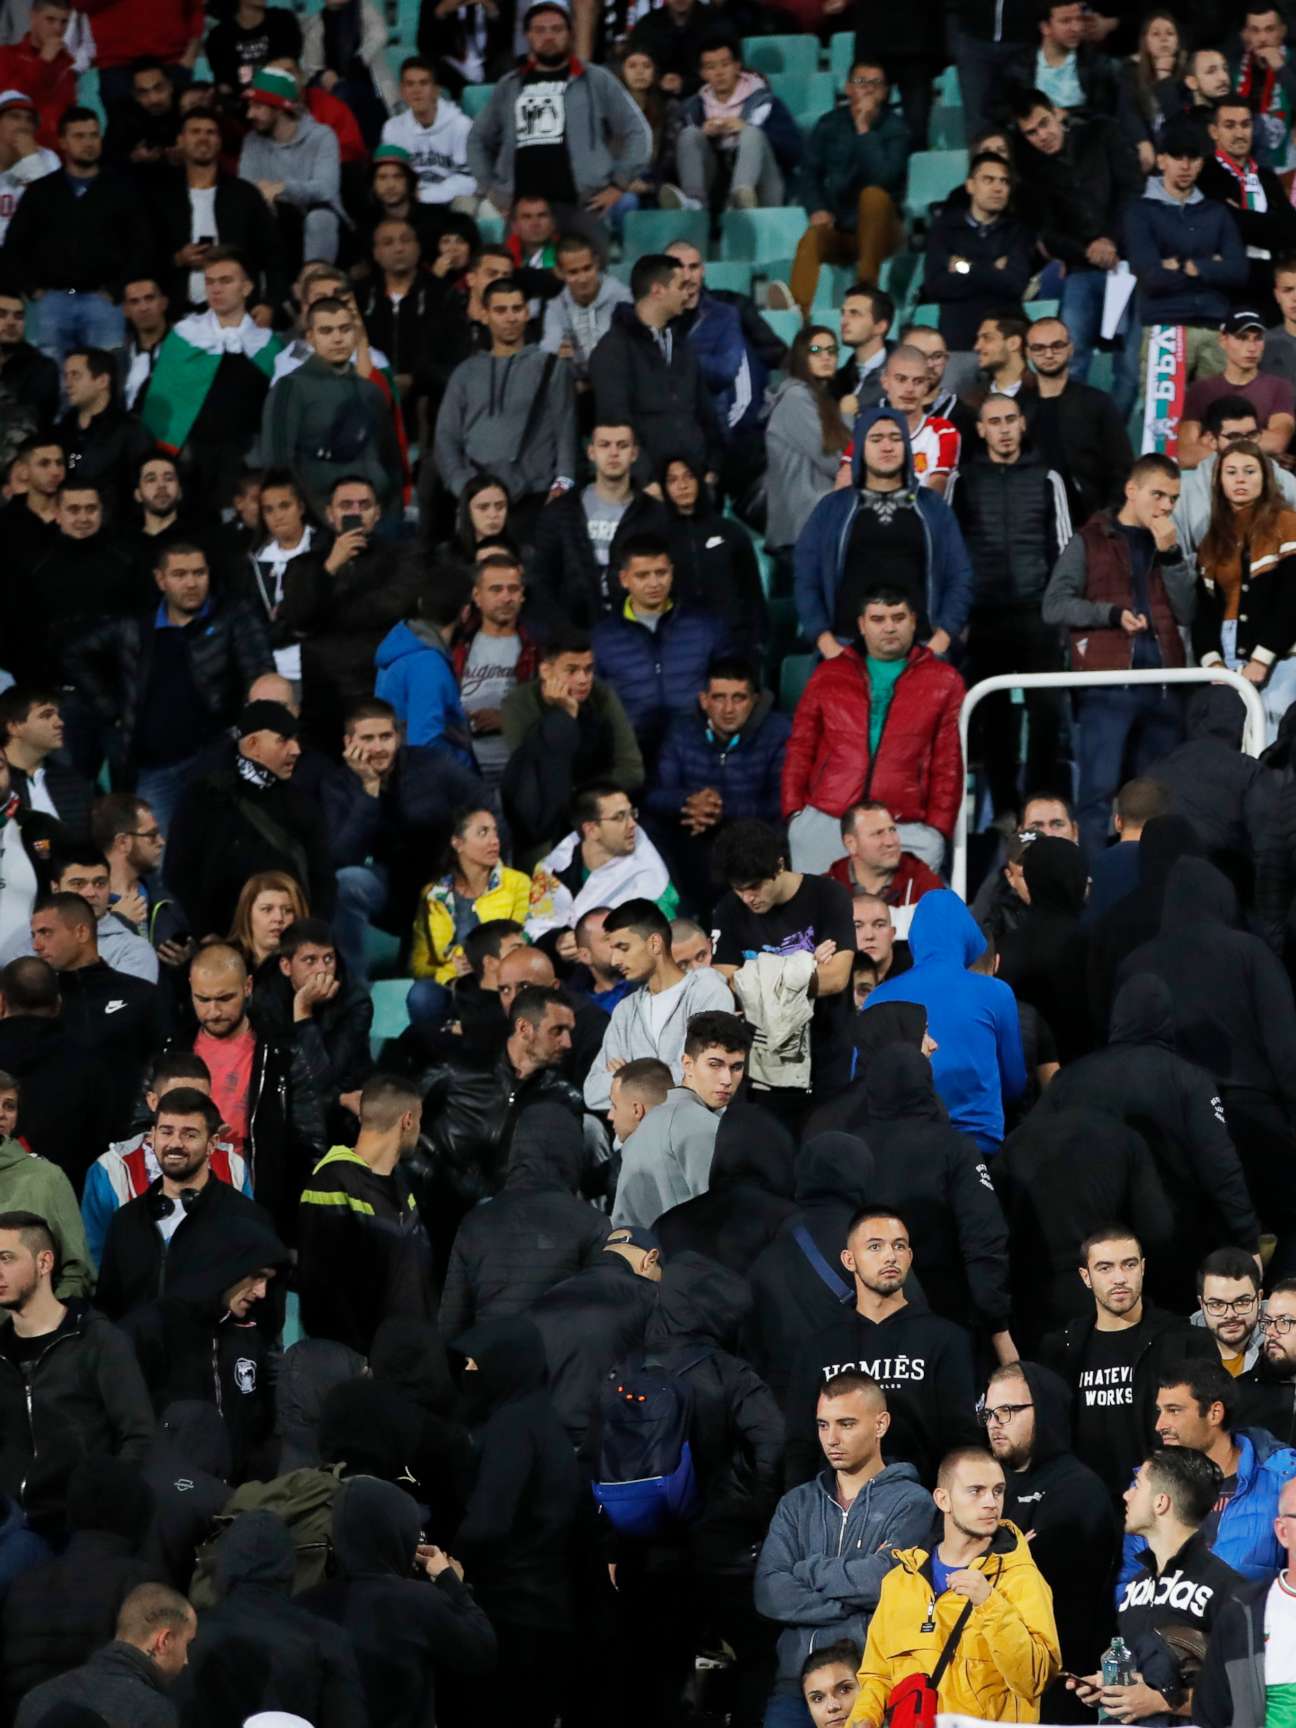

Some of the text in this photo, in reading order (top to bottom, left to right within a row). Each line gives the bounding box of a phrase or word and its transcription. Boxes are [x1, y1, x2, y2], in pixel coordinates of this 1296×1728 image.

[1079, 1366, 1133, 1388] HATEV
[1085, 1387, 1133, 1407] WORKS
[1118, 1569, 1214, 1618] addas
